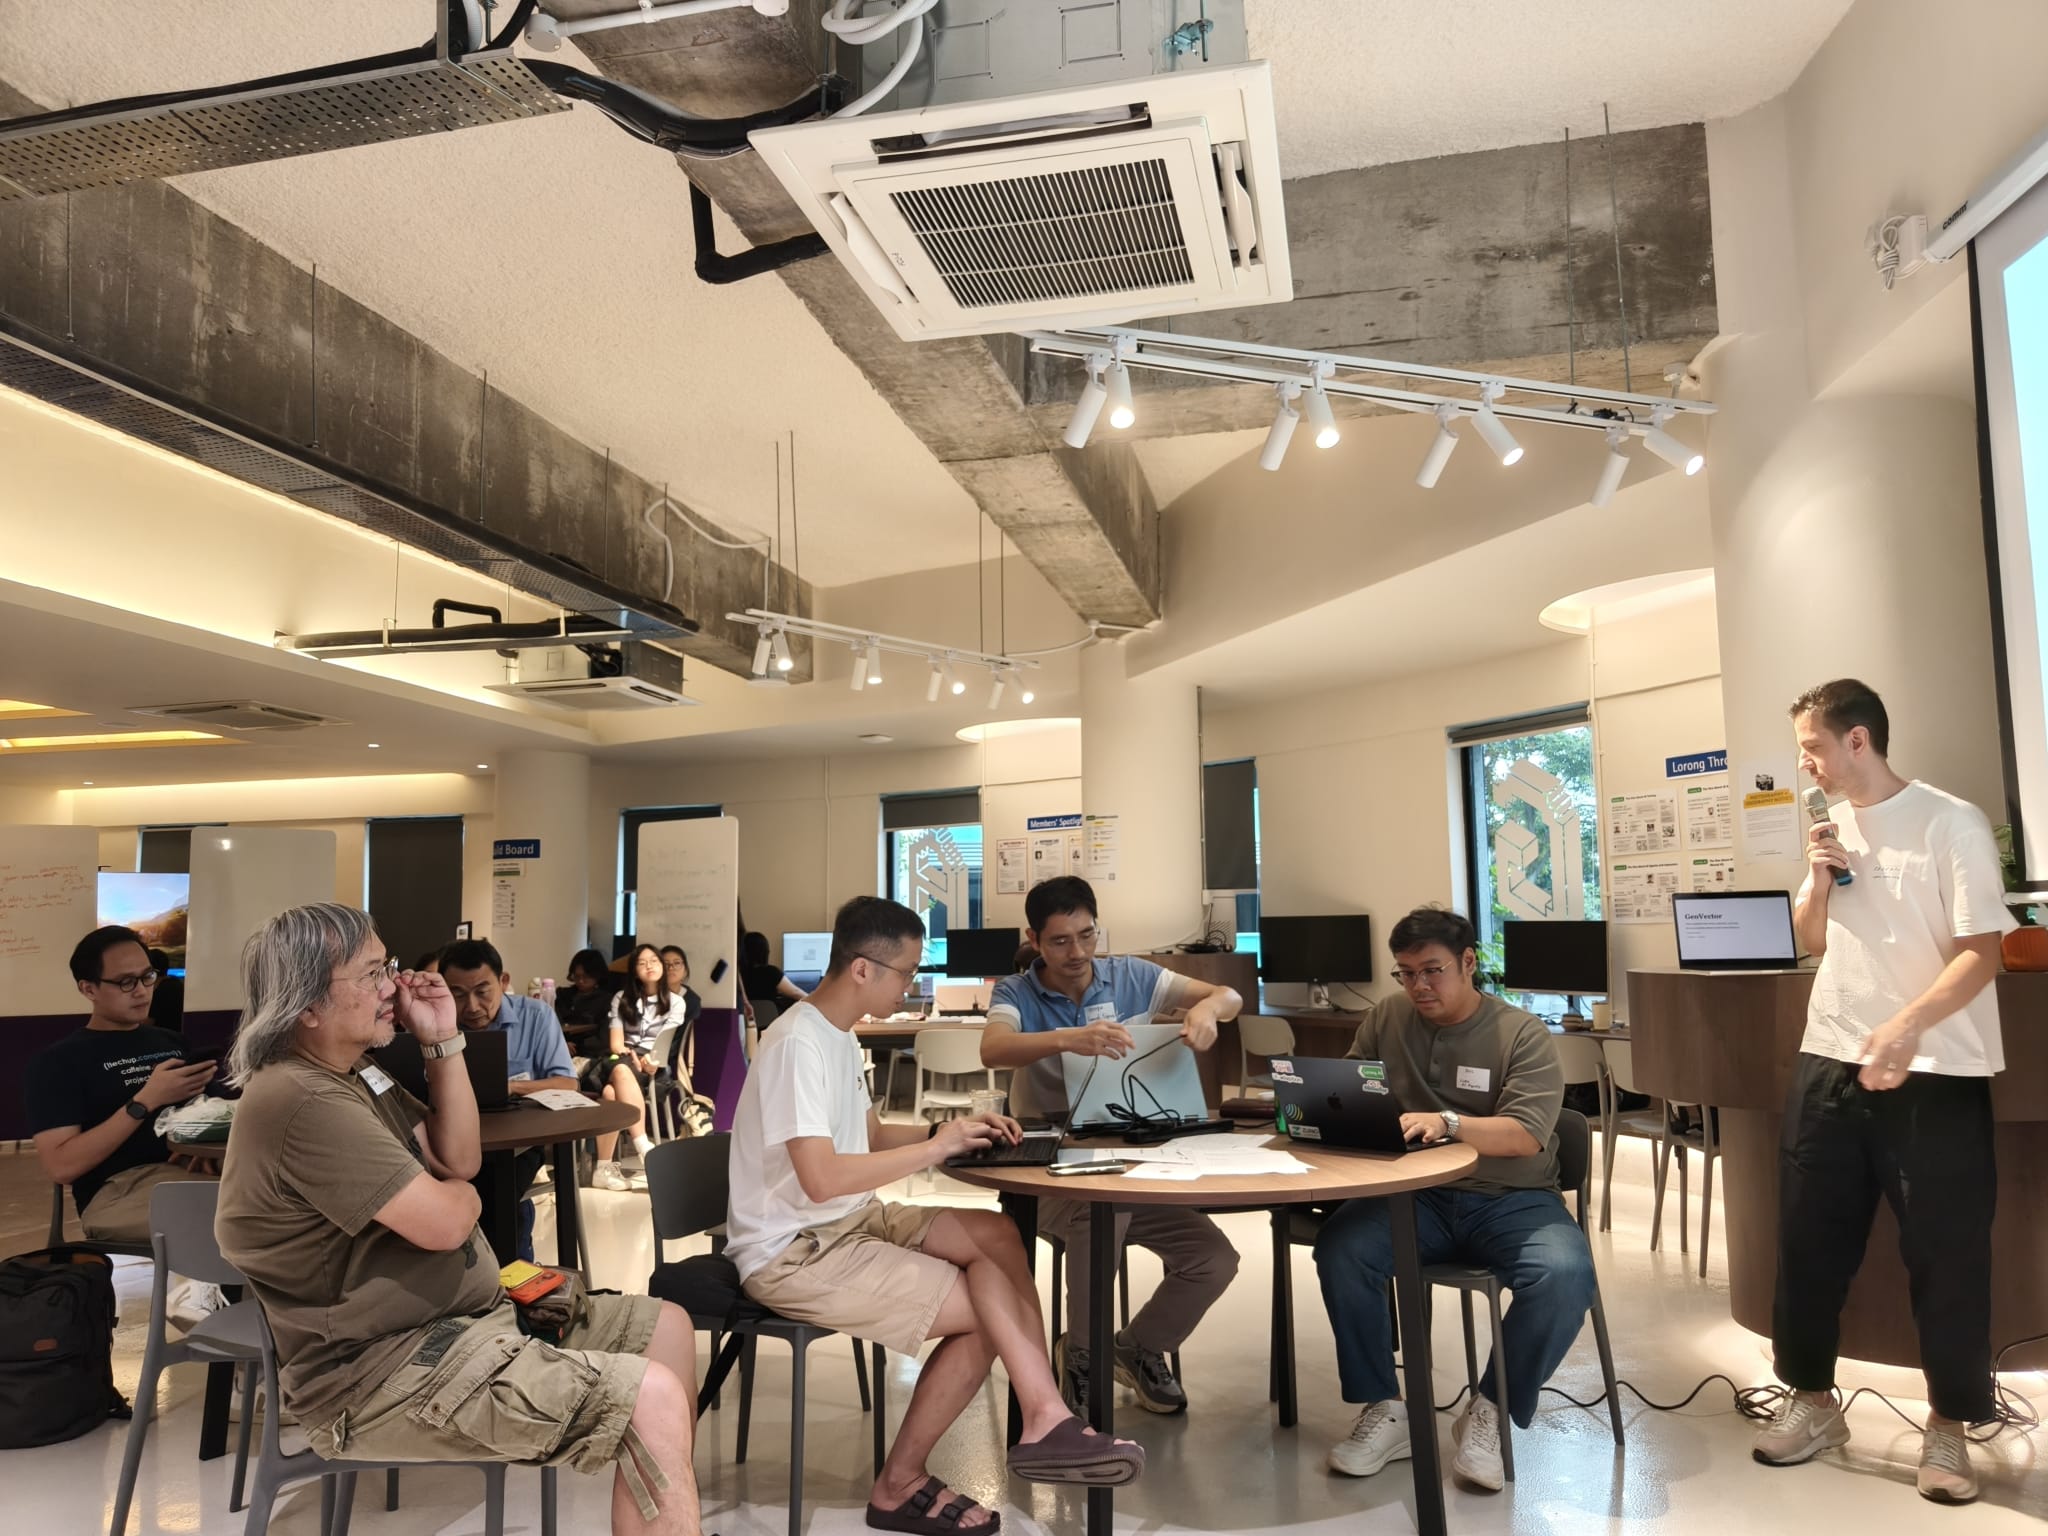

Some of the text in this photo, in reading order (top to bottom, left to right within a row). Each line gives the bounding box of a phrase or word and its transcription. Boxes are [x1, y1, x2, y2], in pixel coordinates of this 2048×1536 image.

[1672, 760, 1705, 773] Lorong
[505, 843, 535, 855] Board
[1684, 913, 1723, 921] GenVector
